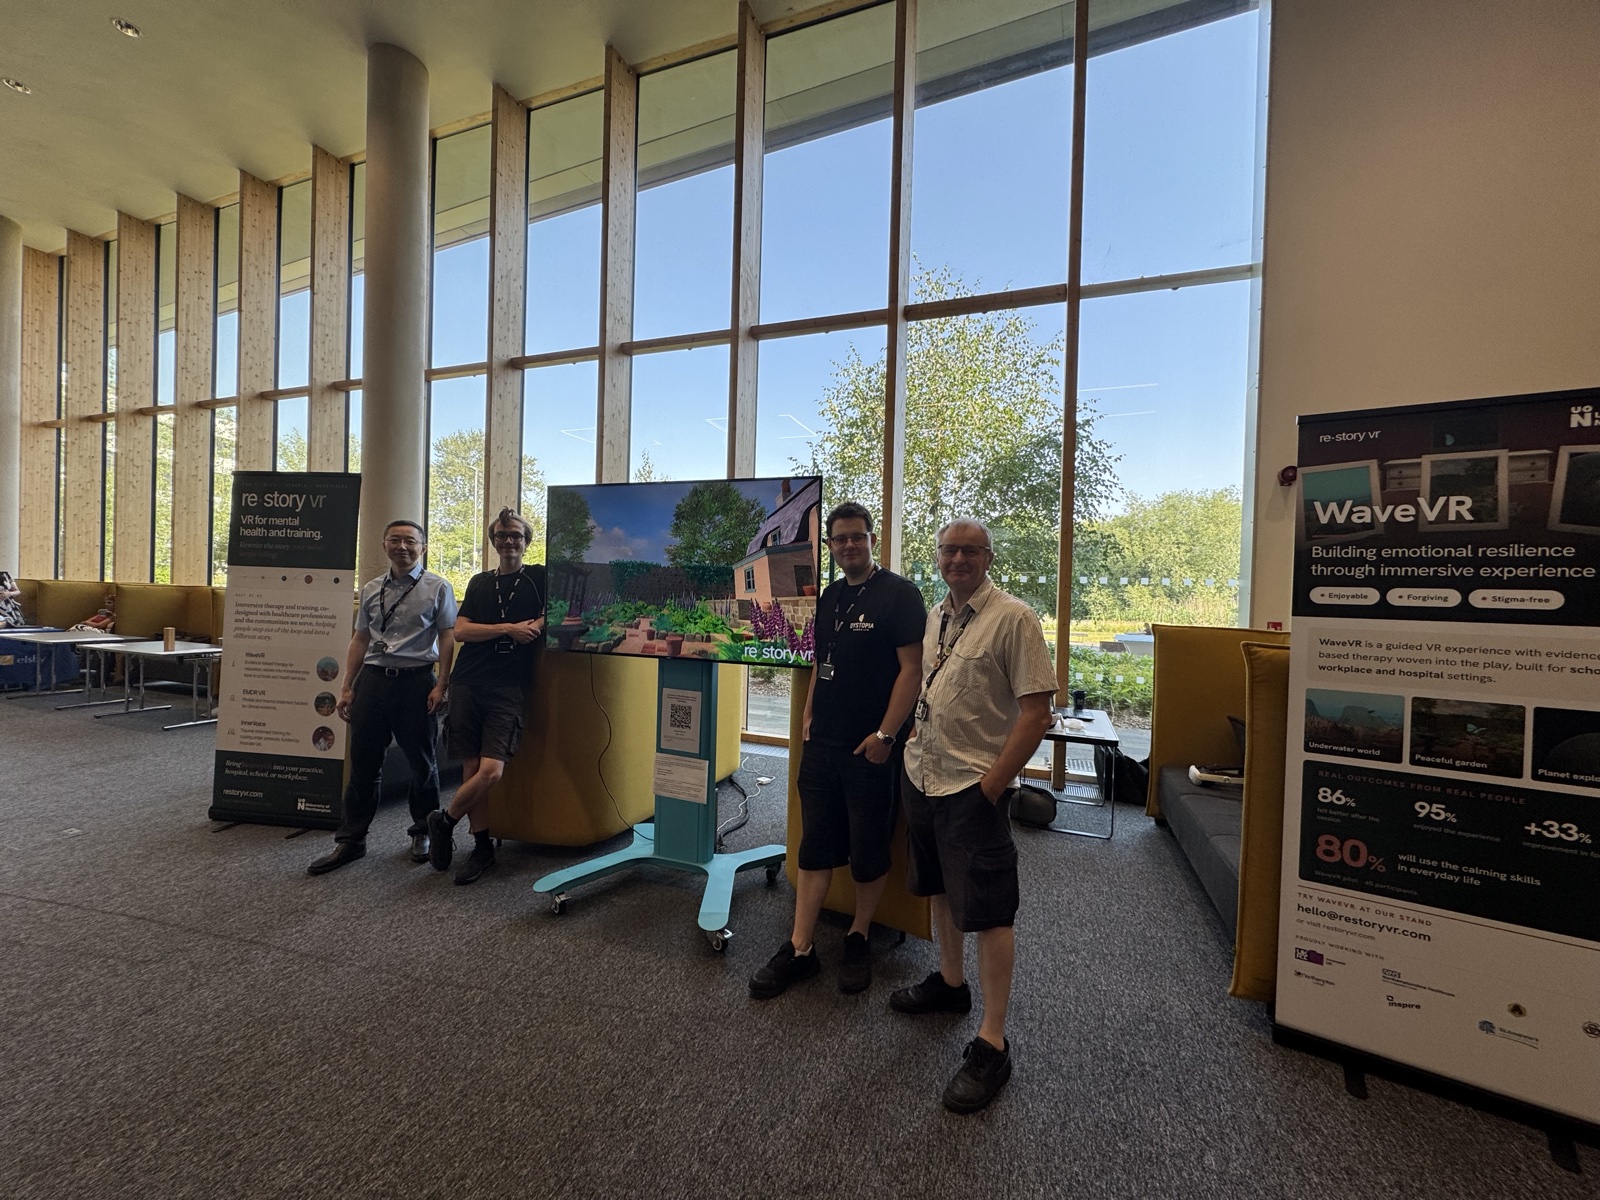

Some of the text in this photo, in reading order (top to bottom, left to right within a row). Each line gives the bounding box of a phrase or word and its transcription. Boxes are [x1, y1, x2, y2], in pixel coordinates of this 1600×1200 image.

[1368, 430, 1382, 439] vr
[309, 494, 327, 509] vr
[1313, 495, 1474, 524] WaveVR
[240, 514, 300, 526] VR for mental
[240, 526, 323, 541] health and training.
[1312, 543, 1576, 561] Building emotional resilience
[1310, 563, 1596, 581] through immersive experience
[1328, 592, 1368, 602] Enjoyable
[1407, 593, 1449, 604] Forgiving
[1492, 594, 1550, 606] Stigma-free
[234, 609, 258, 617] designed
[271, 610, 299, 618] healthcare
[300, 612, 337, 620] professionals
[264, 602, 284, 611] therapy
[315, 621, 337, 629] helping
[744, 646, 814, 664] re story vr
[1318, 638, 1362, 648] WaveVR
[1365, 640, 1374, 648] is
[1385, 641, 1423, 652] guided
[1425, 643, 1442, 652] VR
[1445, 644, 1511, 657] experience
[1515, 648, 1542, 658] with
[1318, 650, 1349, 660] based
[1352, 652, 1393, 664] therapy
[1396, 656, 1433, 665] woven
[1435, 656, 1457, 666] into
[1460, 658, 1480, 668] the
[1483, 659, 1512, 672] play,
[1515, 662, 1544, 672] built
[1547, 663, 1566, 673] for
[1318, 663, 1496, 684] workplace and hospital settings.
[1308, 740, 1381, 756] Underwater world
[1415, 754, 1488, 770] Peaceful garden
[1538, 768, 1570, 779] Planet
[1318, 770, 1526, 805] REAL OUTCOMES FROM REAL PEOPLE
[1317, 786, 1356, 808] 86%
[1413, 800, 1458, 824] 95%
[1413, 823, 1501, 842] enjoyed the experience
[1524, 820, 1593, 845] +33%
[1316, 834, 1386, 873] 80%
[1398, 854, 1542, 886] will use the calming skills
[1398, 863, 1481, 886] in everyday life
[1297, 892, 1314, 900] TRY
[1317, 896, 1356, 910] WAVEVR
[1374, 909, 1395, 919] OUR
[1399, 914, 1432, 927] STAND
[1297, 903, 1431, 942] hello@restoryvr.com
[1306, 920, 1321, 928] visit
[1322, 924, 1376, 941] restoryvr.com
[1295, 934, 1385, 961] PROUDLY WORKING WITH
[1388, 1001, 1421, 1010] inspire
